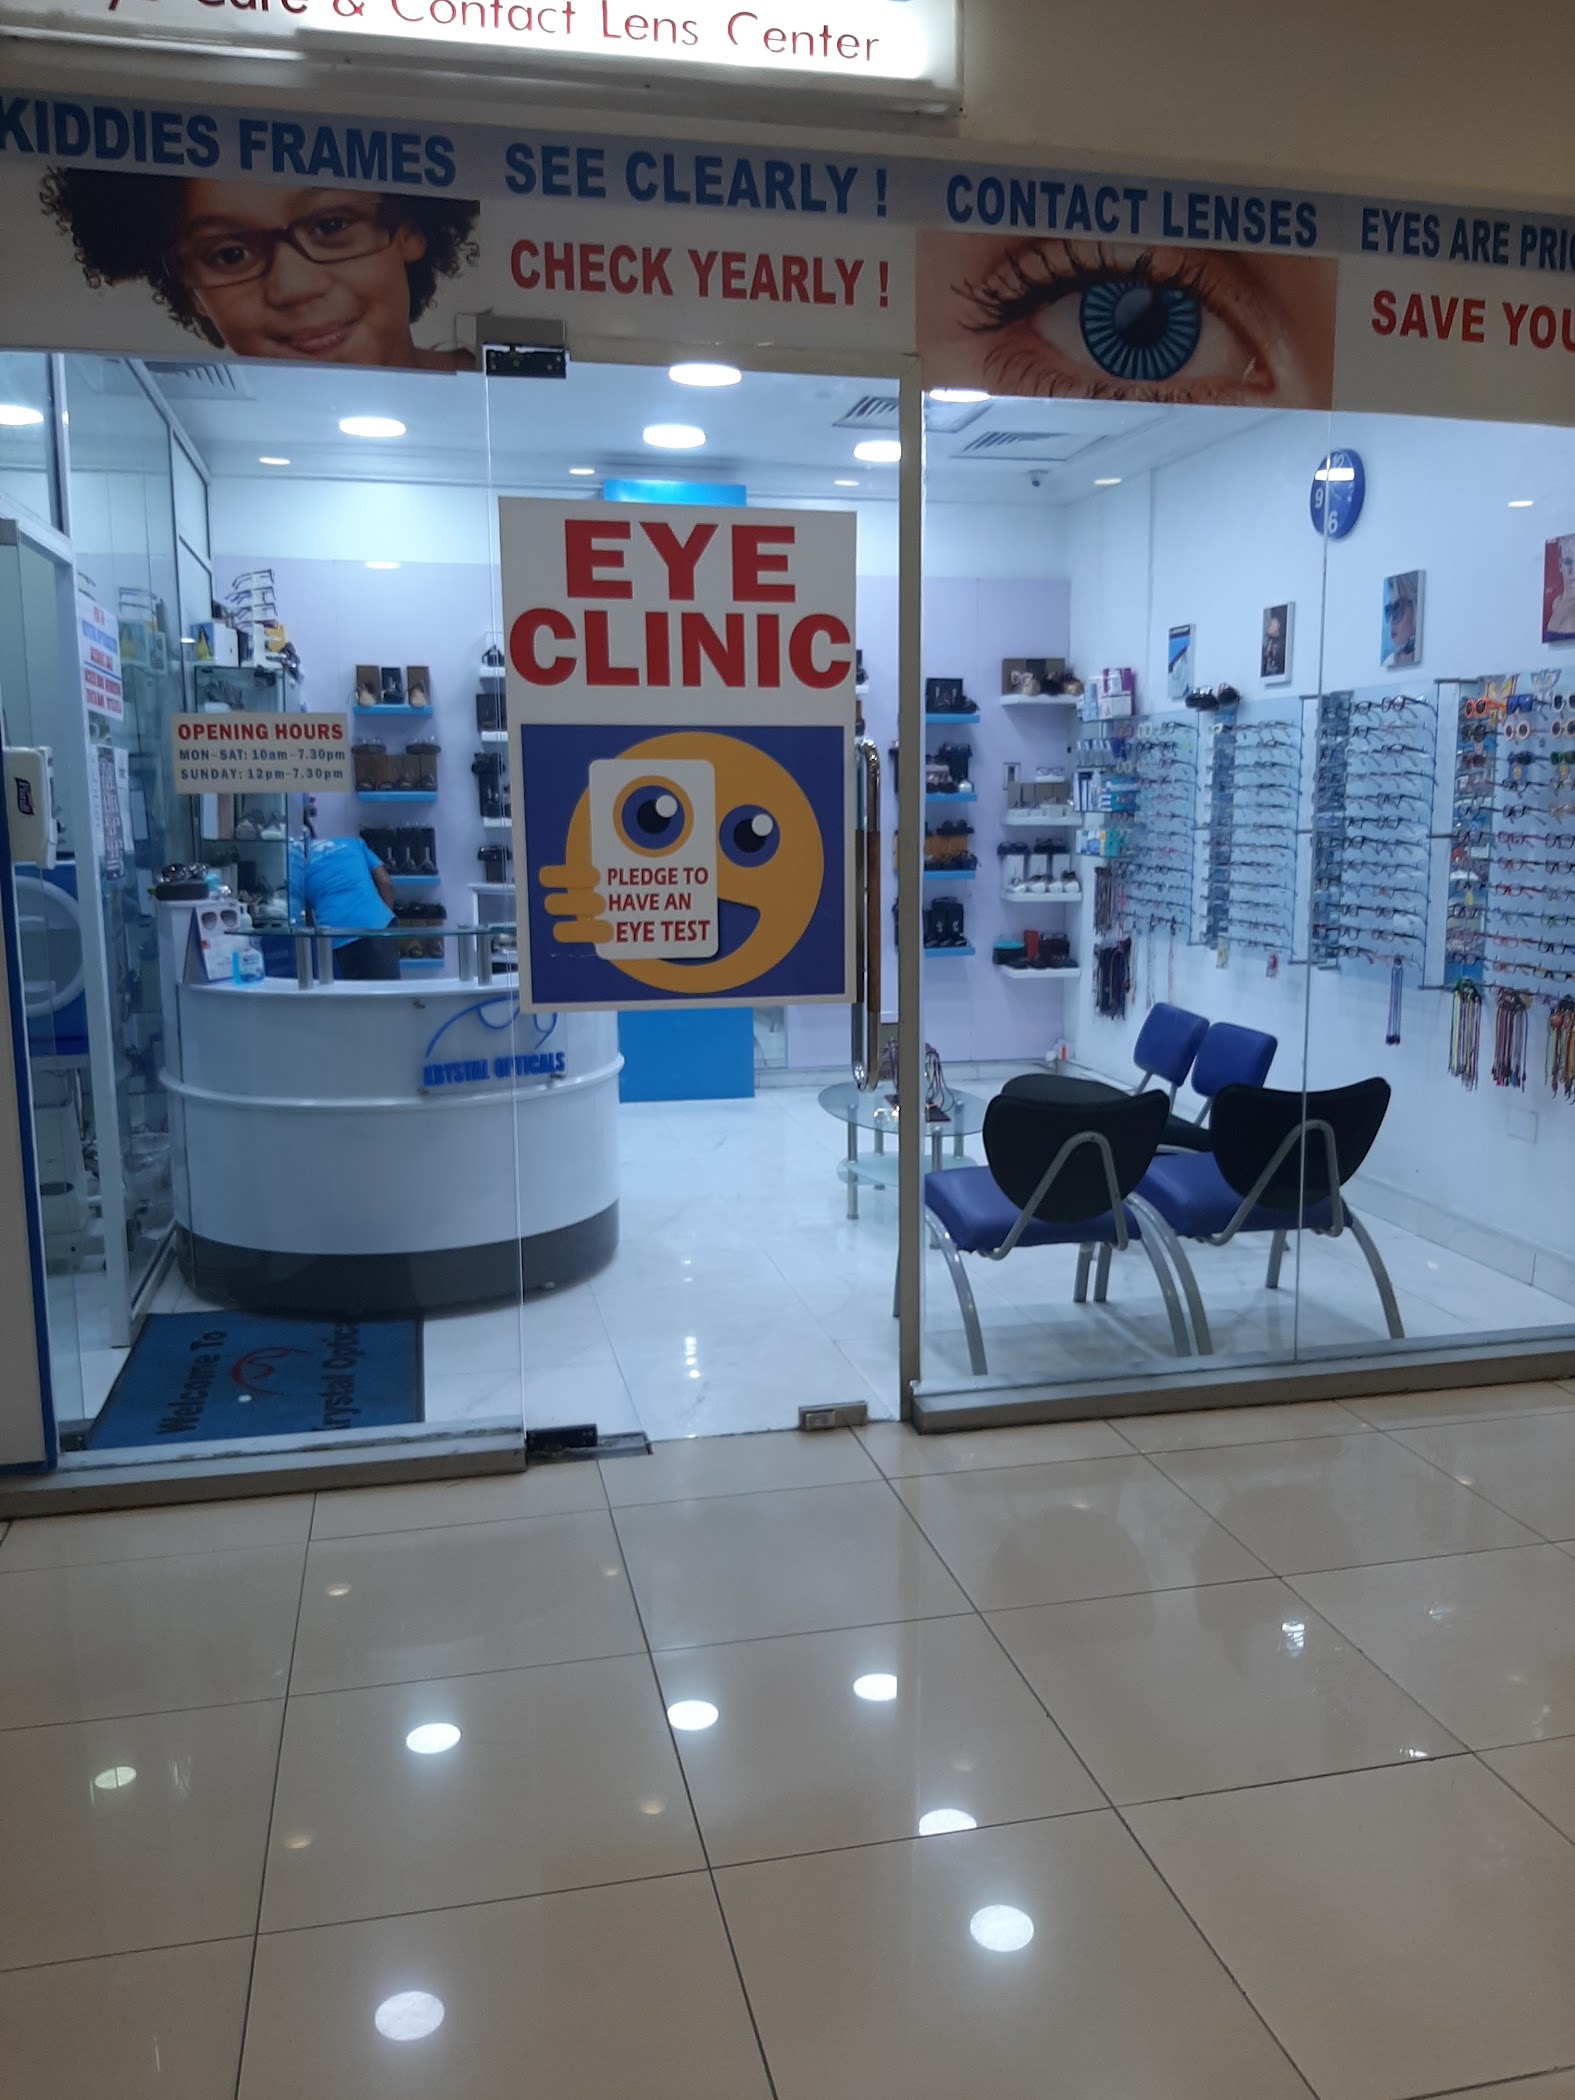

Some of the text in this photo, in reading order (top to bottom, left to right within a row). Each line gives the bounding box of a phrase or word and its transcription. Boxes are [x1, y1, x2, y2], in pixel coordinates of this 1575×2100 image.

[391, 0, 576, 35] Contact
[602, 0, 699, 46] Lens
[727, 11, 880, 61] Center
[0, 96, 456, 187] KIDDIES FRAMES
[505, 142, 607, 198] SEE
[625, 151, 858, 214] CLEARLY
[947, 174, 1318, 248] CONTACT LENSES
[1361, 207, 1440, 258] EYES
[1450, 216, 1510, 266] ARE
[511, 239, 673, 296] CHECK
[688, 249, 864, 307] YEARLY
[1371, 289, 1486, 343] SAVE
[1315, 486, 1324, 509] 9
[1328, 510, 1339, 535] 6
[564, 519, 796, 603] EYE
[509, 608, 852, 689] CLINIC
[178, 723, 343, 741] OPENING HOURS
[181, 768, 243, 780] SUNDAY:
[607, 867, 709, 887] PLEDGE TO
[609, 893, 692, 912] HAVE AN
[616, 920, 711, 943] EYE TEST
[155, 1354, 221, 1435] Welcome
[311, 1375, 361, 1432] rystal
